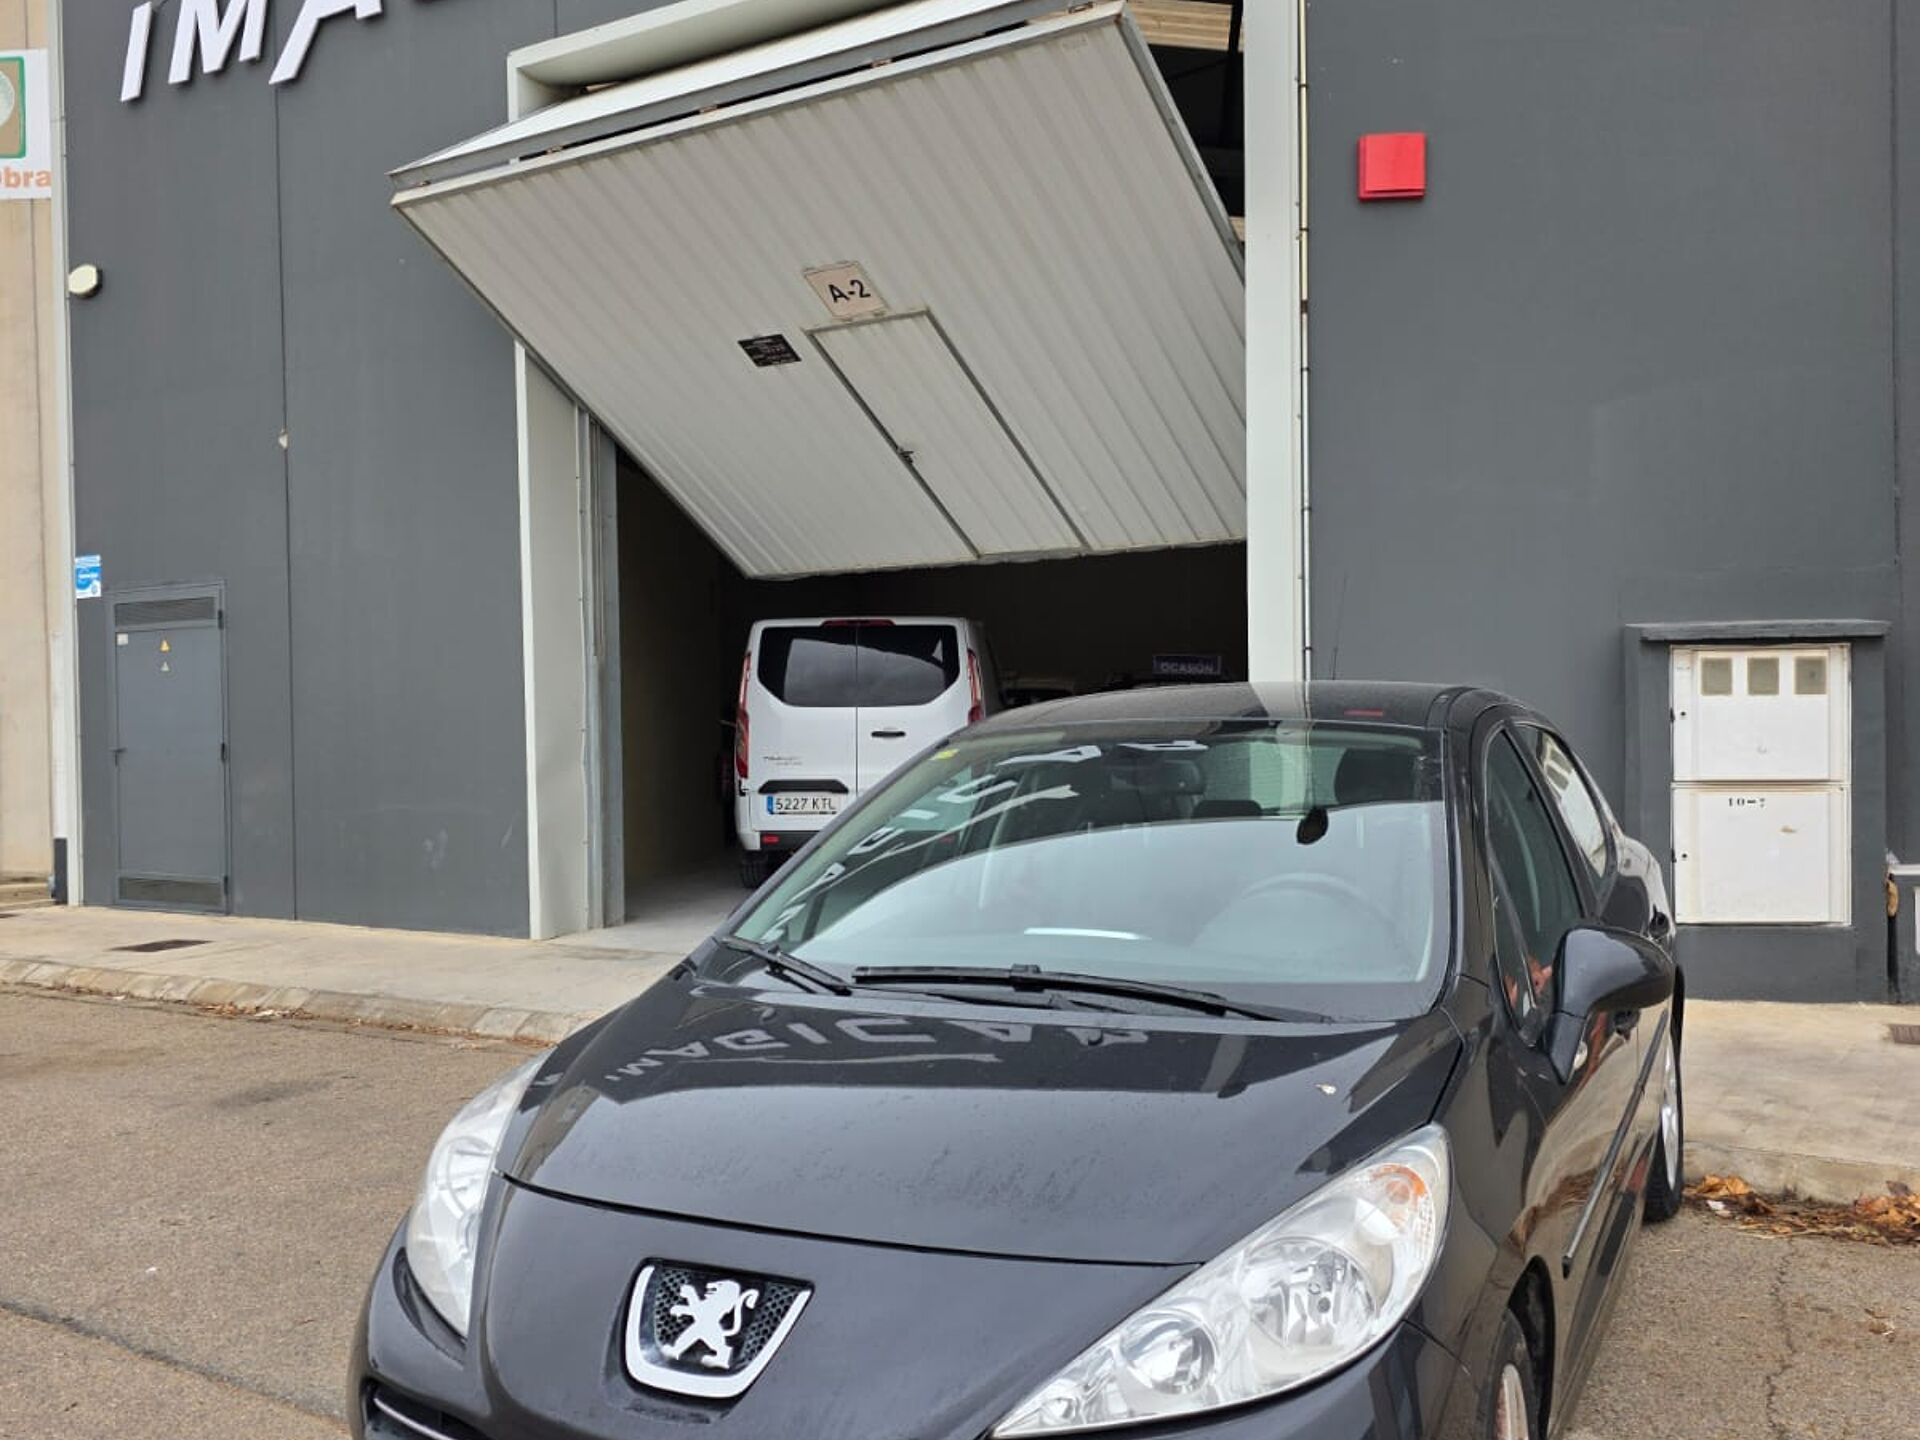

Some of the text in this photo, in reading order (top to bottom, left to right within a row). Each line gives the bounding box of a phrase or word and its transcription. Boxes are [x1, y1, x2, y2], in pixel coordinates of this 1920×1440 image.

[0, 166, 52, 188] bra
[828, 279, 871, 303] A-2
[775, 797, 837, 811] 5227 KTL
